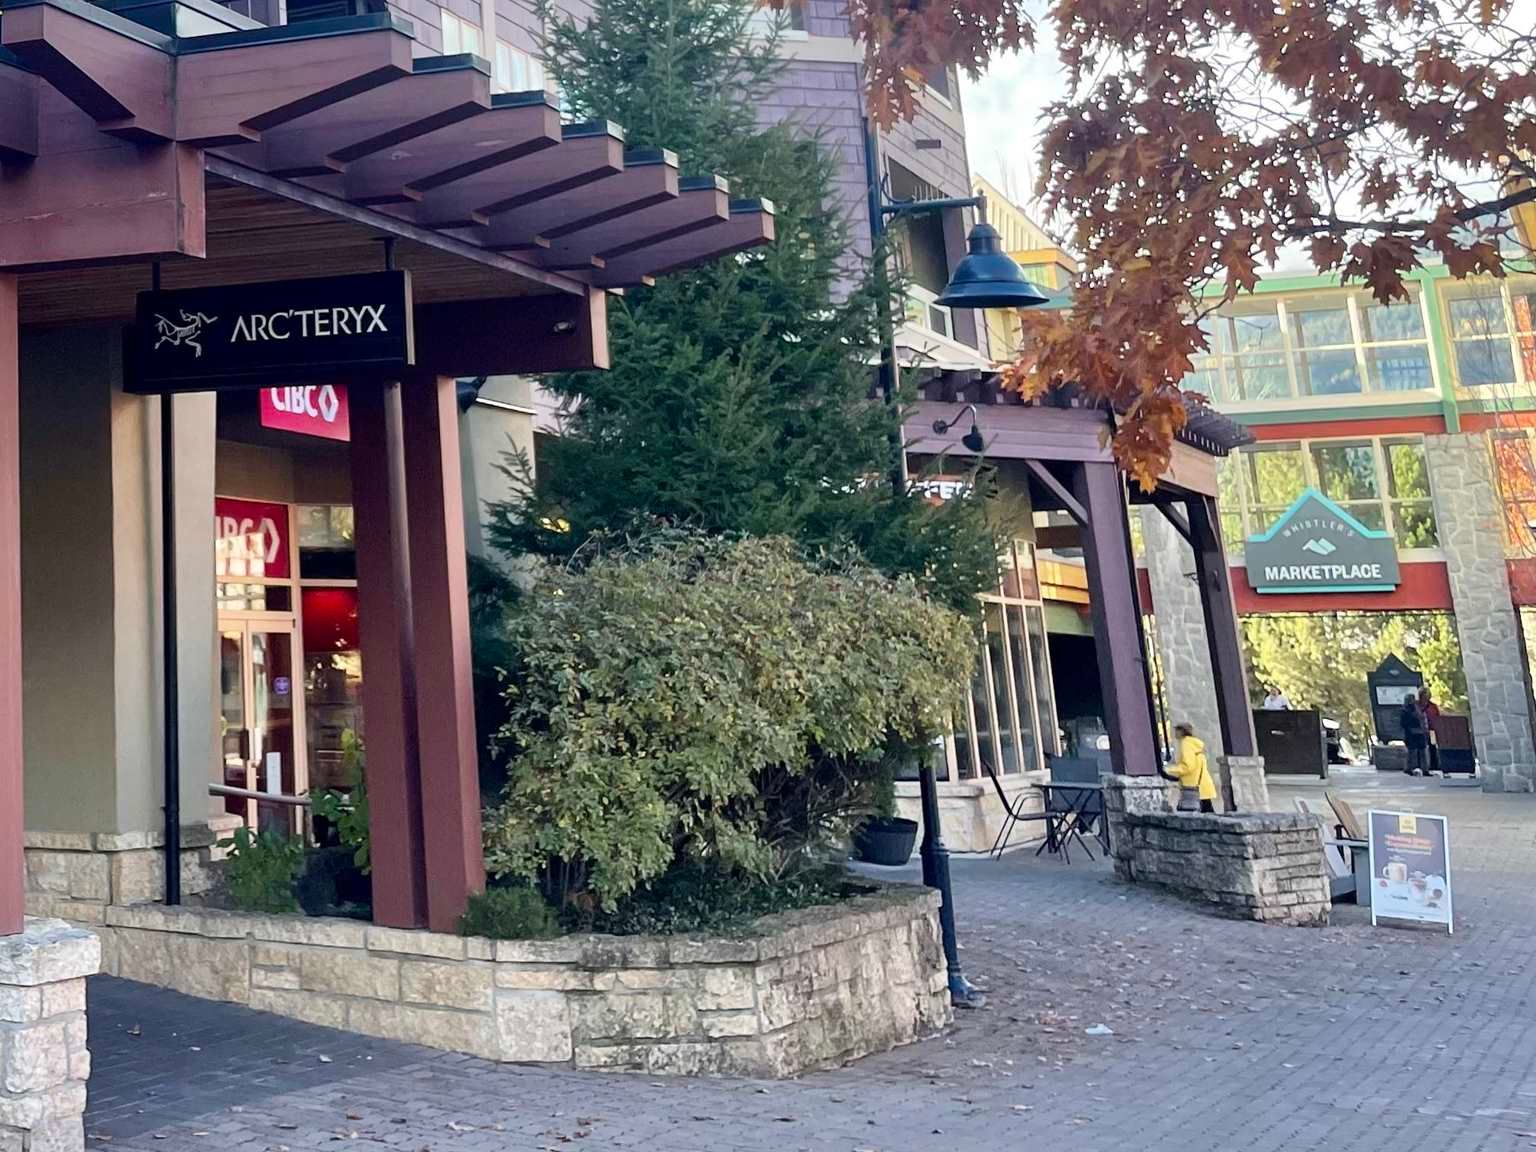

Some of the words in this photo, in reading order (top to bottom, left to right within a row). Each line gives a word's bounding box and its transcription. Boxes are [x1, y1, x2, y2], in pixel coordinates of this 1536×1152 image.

[230, 304, 389, 343] ARC'TERYX
[270, 385, 319, 418] CIBC
[215, 515, 256, 557] IBC
[1264, 563, 1383, 580] MARKETPLACE
